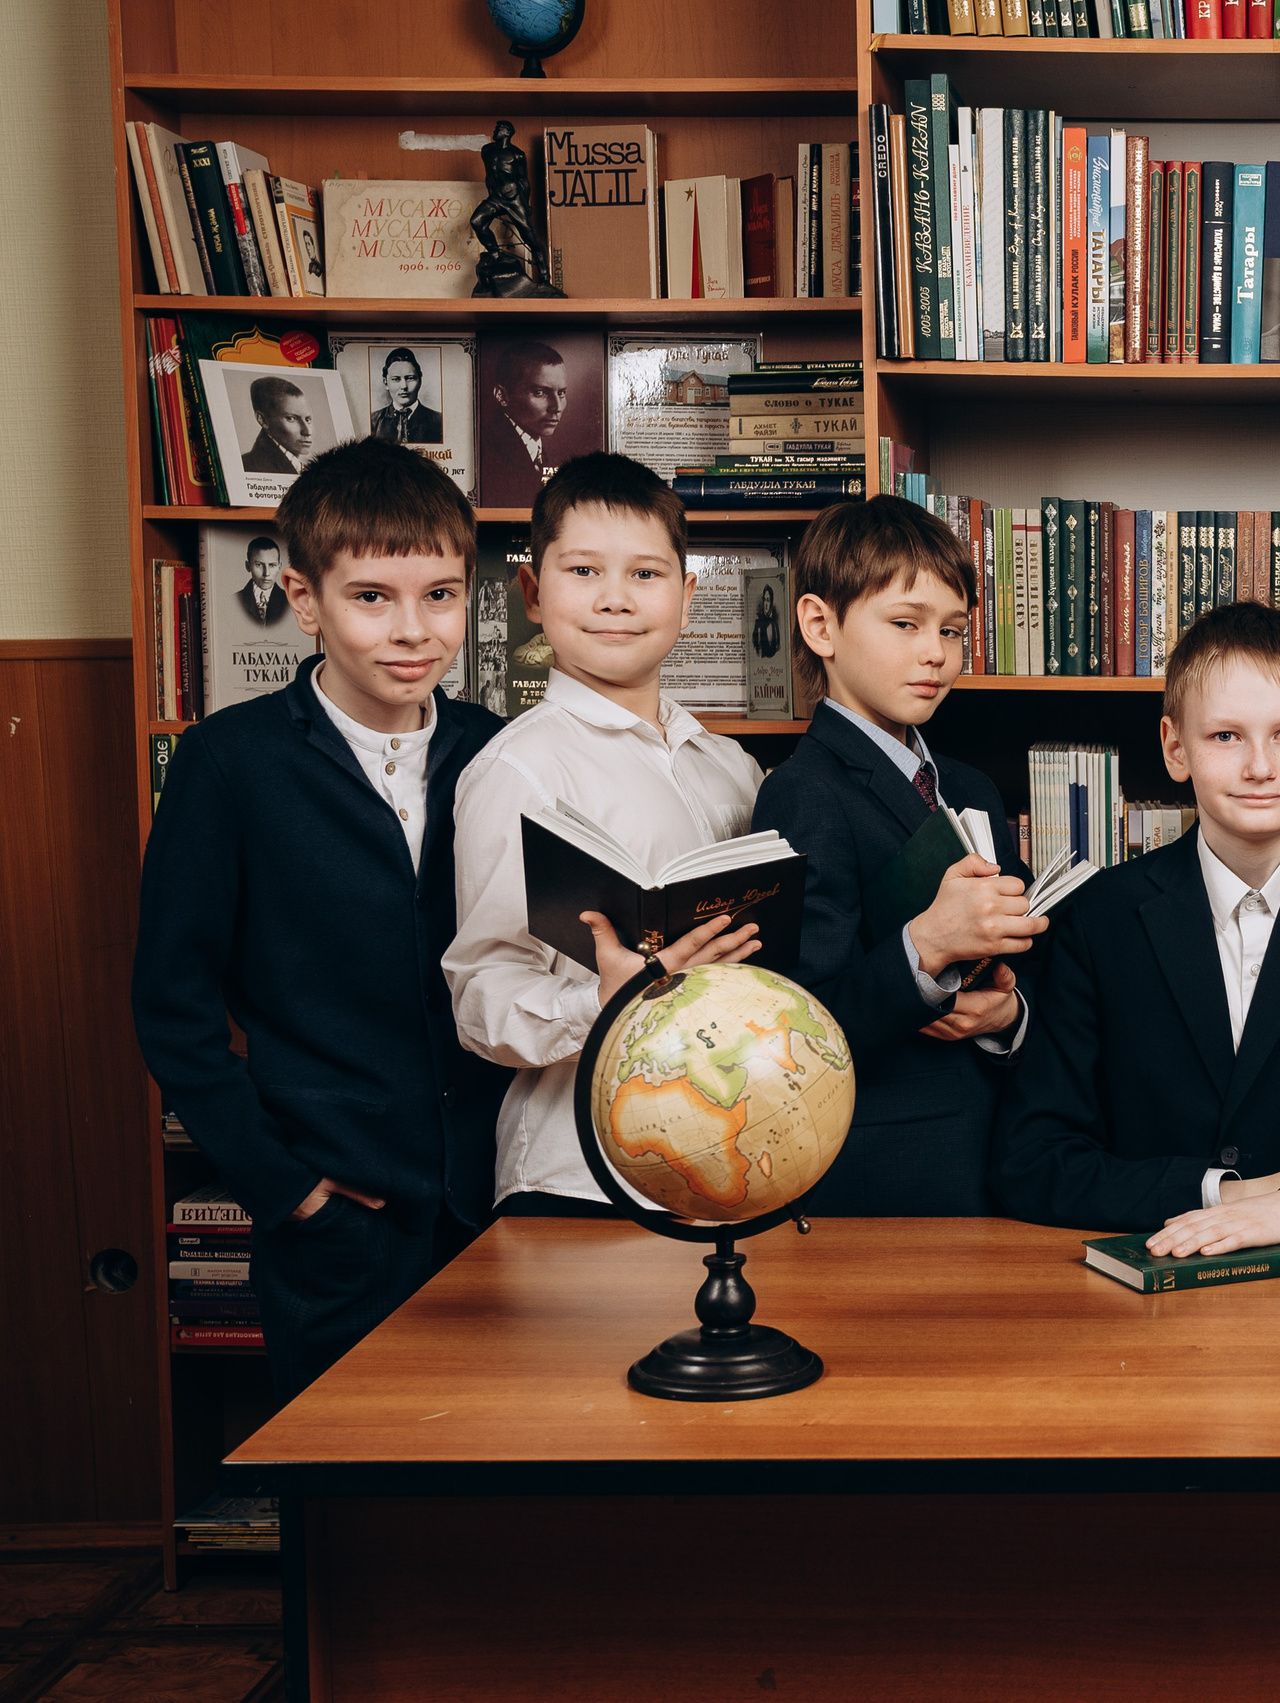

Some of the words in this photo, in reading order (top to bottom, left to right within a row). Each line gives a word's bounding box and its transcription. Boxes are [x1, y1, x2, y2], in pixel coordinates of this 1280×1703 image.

[546, 131, 645, 166] Mussa
[876, 134, 887, 178] CREDO
[1134, 149, 1142, 182] РАЙОН
[549, 168, 646, 207] JALIL
[1089, 156, 1109, 227] Знаменитые
[363, 198, 425, 218] МУСА
[832, 193, 843, 254] ДЖАЛИЛЬ
[214, 234, 223, 253] МУСА
[351, 219, 411, 239] МУСА
[357, 239, 425, 259] MUSSA
[962, 205, 972, 287] КАЗАНЕВЕДЕНИЕ
[398, 261, 425, 275] 1906
[434, 261, 461, 275] 1966
[832, 261, 842, 293] МУСА
[1091, 229, 1106, 303] ТАТАРЫ
[1236, 226, 1259, 304] Татары
[1071, 275, 1079, 308] КУЛАК
[919, 287, 931, 338] 1005-2005
[1070, 310, 1078, 341] ТАНКОВЫЙ
[1132, 304, 1141, 349] КАЗАНЦЫ
[819, 397, 855, 408] ТУКАЕ
[814, 417, 857, 433] ТУКАЙ
[452, 467, 465, 475] лет
[729, 481, 780, 489] ГАБДУЛЛА
[783, 480, 816, 489] ТУКАЙ
[247, 483, 277, 492] Габдулла
[986, 565, 994, 577] АК
[1015, 538, 1024, 598] ГИЛЯЗОВ
[1030, 540, 1038, 599] ГИЛЯЗОВ
[715, 585, 737, 593] Байрон
[1138, 559, 1149, 616] БӘШИРОВ
[1016, 603, 1025, 630] АЯЗ
[1031, 604, 1039, 631] АЯЗ
[1139, 619, 1149, 658] ГОМӘР
[181, 650, 189, 692] ГАБДУЛЛА
[232, 652, 300, 666] ГАБДУЛЛА
[244, 667, 290, 682] ТУКАЙ
[754, 683, 784, 698] БАЙРОН
